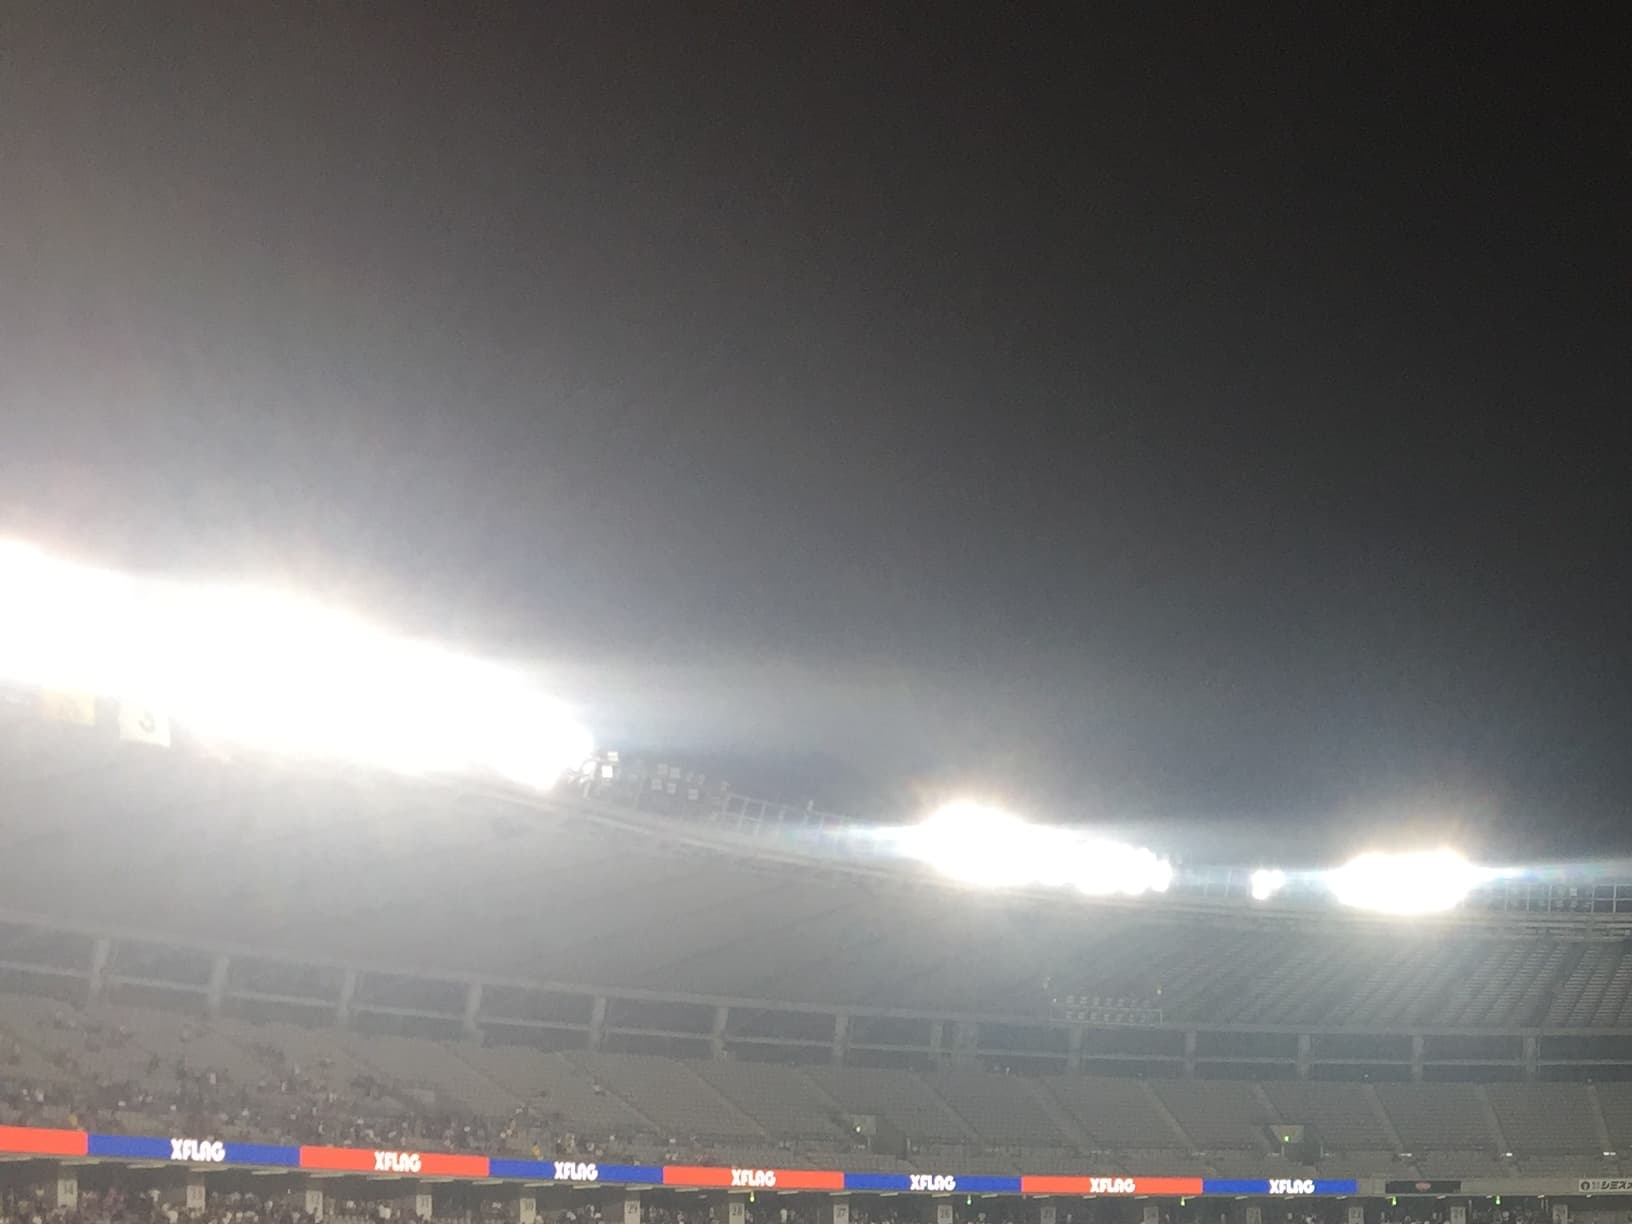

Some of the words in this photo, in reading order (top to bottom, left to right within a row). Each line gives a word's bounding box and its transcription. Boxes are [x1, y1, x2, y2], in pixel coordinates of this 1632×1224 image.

[171, 1138, 226, 1162] XFLAG
[375, 1152, 422, 1173] XFLAG
[554, 1161, 599, 1181] XFLAG
[731, 1169, 777, 1187] XFLAG
[910, 1175, 956, 1191] XFLAG
[1090, 1178, 1136, 1194] XFLAG
[1269, 1179, 1315, 1195] XFLAG
